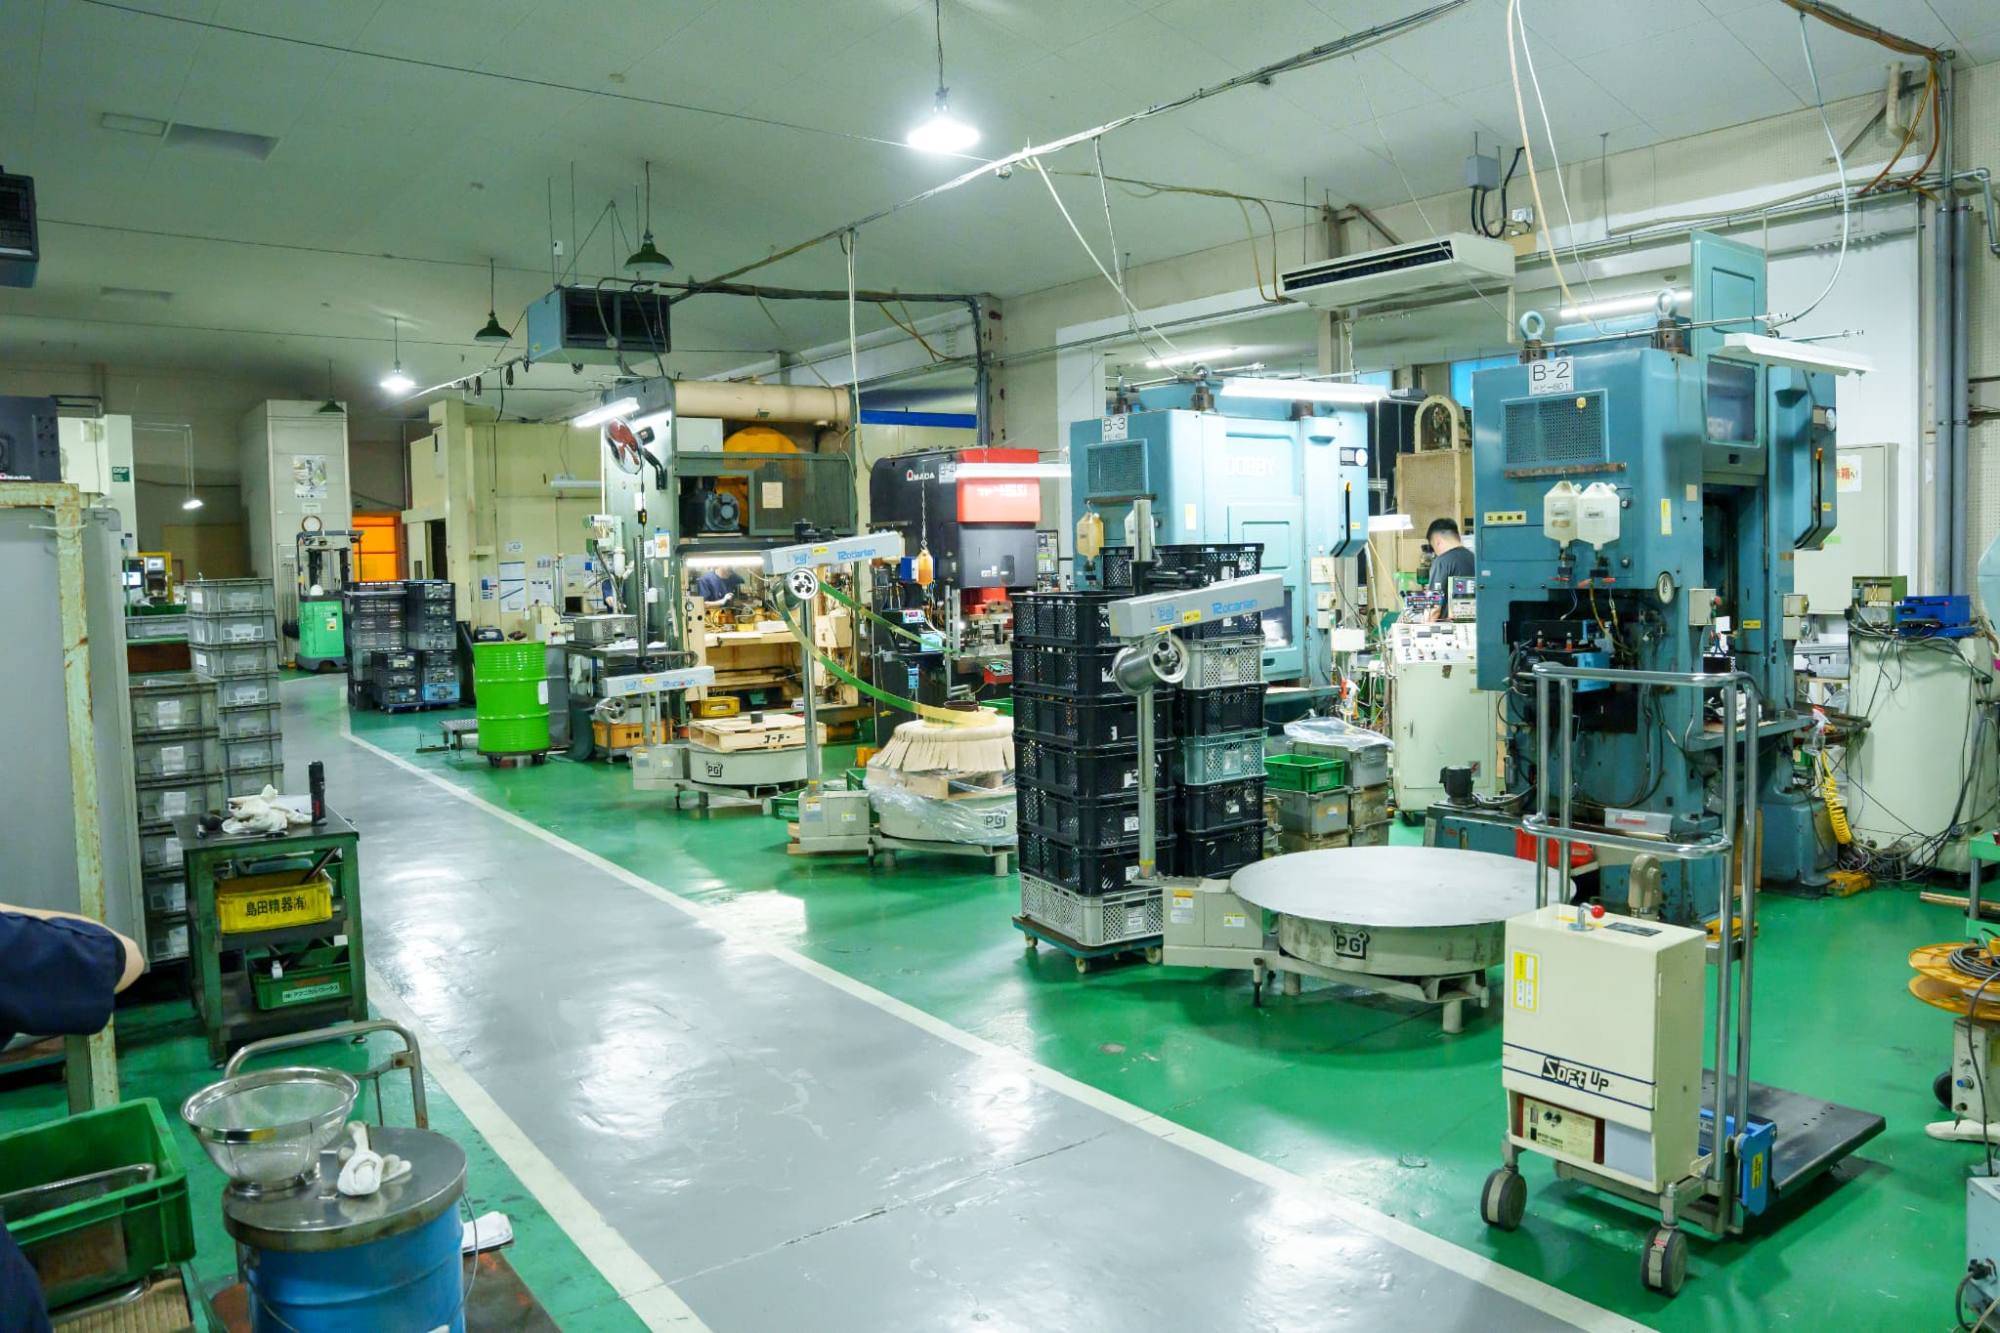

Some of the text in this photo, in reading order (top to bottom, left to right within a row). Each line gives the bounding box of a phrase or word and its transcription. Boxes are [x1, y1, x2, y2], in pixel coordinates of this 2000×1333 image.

[1533, 361, 1570, 382] B-2
[1103, 416, 1126, 433] B-3
[1336, 936, 1362, 953] PG
